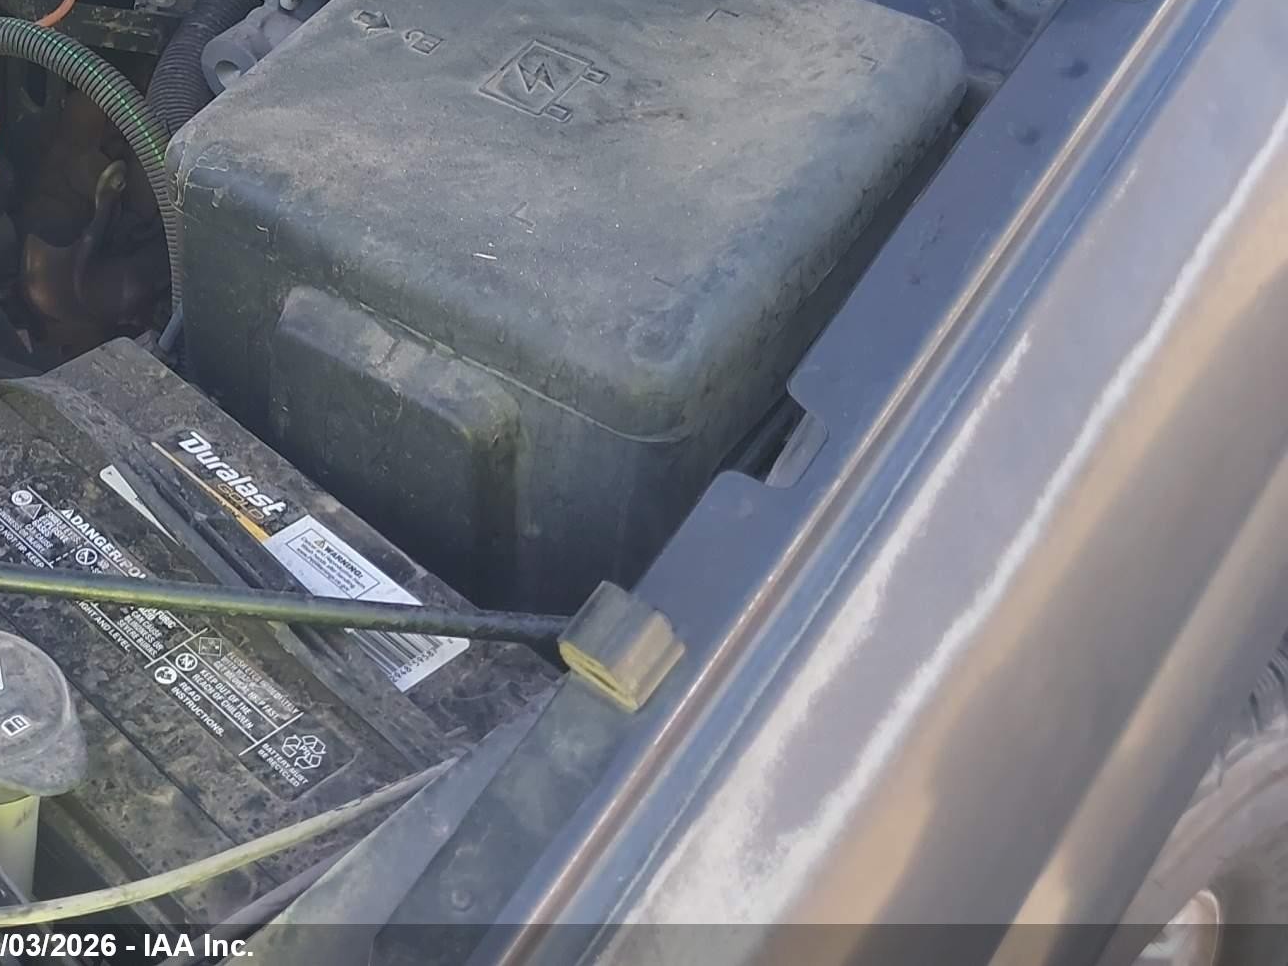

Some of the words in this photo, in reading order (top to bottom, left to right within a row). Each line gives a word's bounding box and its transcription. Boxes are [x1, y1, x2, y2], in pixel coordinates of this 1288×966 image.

[178, 430, 287, 518] Duralast
[216, 482, 264, 521] GOLD
[2, 530, 17, 541] NOT
[25, 551, 45, 567] KEEP
[327, 547, 364, 577] WARNING:
[94, 615, 112, 630] AND
[117, 619, 140, 638] SEVERE
[124, 614, 156, 641] BLINDNESS
[131, 610, 146, 621] CAN
[142, 620, 163, 637] CAUSE
[179, 681, 202, 700] READ
[192, 673, 215, 692] REACH
[212, 692, 225, 701] OF
[200, 668, 219, 683] KEEP
[215, 682, 231, 695] OUT
[228, 694, 241, 703] OF
[237, 702, 252, 714] THE
[171, 686, 226, 734] INSTRUCTIONS.
[257, 748, 269, 758] BE
[266, 756, 300, 787] RECYCLED
[262, 743, 291, 767] BATTERY
[287, 766, 309, 784] MUST
